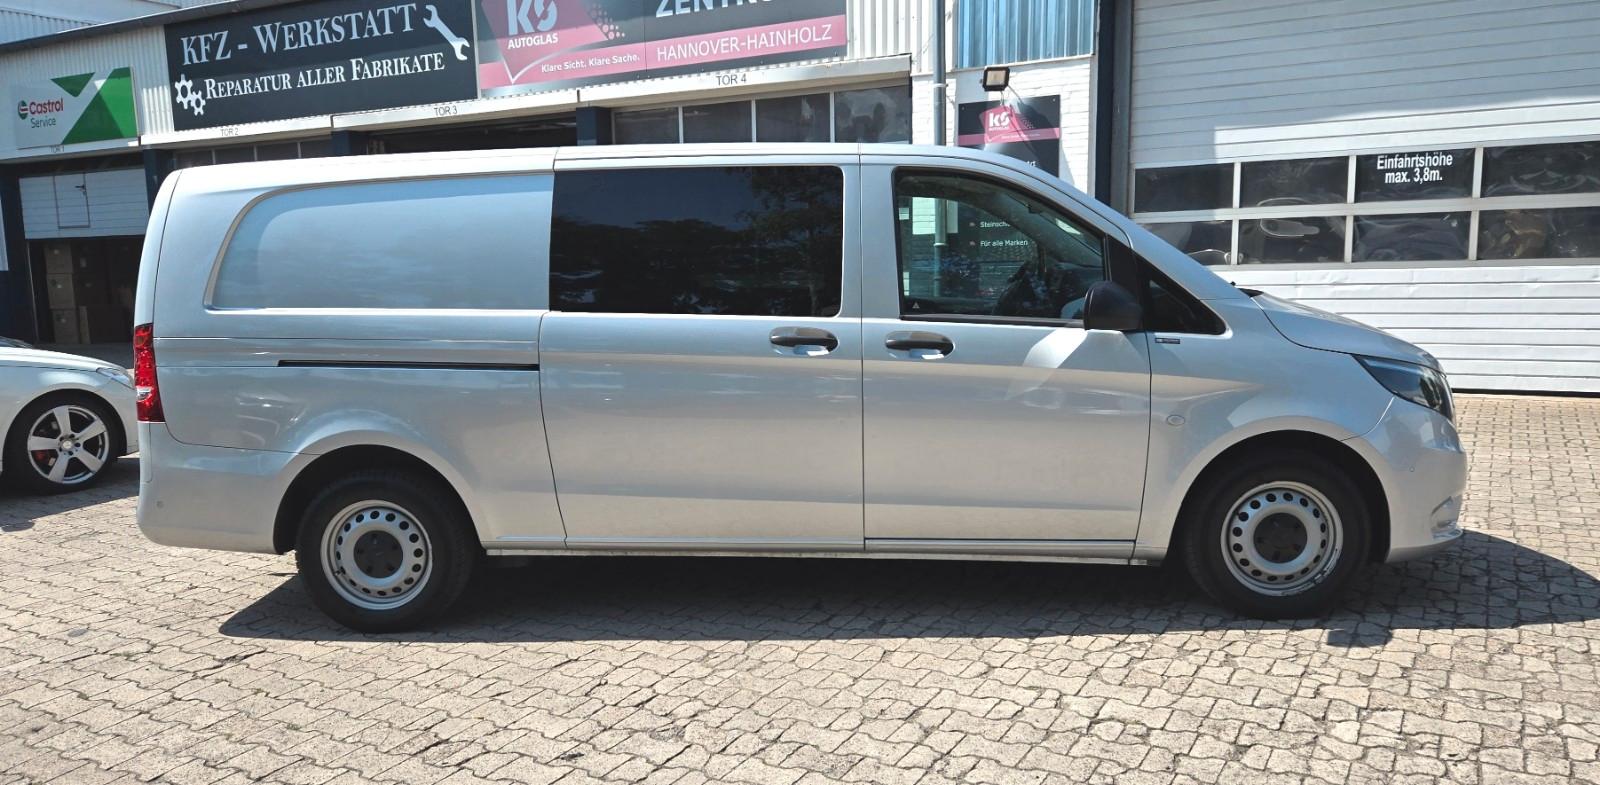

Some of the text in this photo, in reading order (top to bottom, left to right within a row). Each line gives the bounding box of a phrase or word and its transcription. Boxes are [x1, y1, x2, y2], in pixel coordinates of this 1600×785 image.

[180, 30, 232, 65] KFZ
[253, 3, 417, 54] WERKSTATT
[507, 33, 559, 50] AUTOGLAS
[656, 24, 832, 62] HANNOVER-HAINHOLZ
[541, 53, 640, 73] Klare Sicht. Klare Sache.
[204, 52, 445, 100] REPARATUR ALLER FABRIKATE
[716, 73, 747, 86] TOR 4
[29, 97, 64, 115] Castrol
[434, 105, 458, 116] TOR 3
[31, 116, 57, 128] Service
[220, 127, 239, 137] TOR 2
[1377, 152, 1453, 170] Einfahrtshöhe
[1385, 167, 1443, 184] max. 3,8m.
